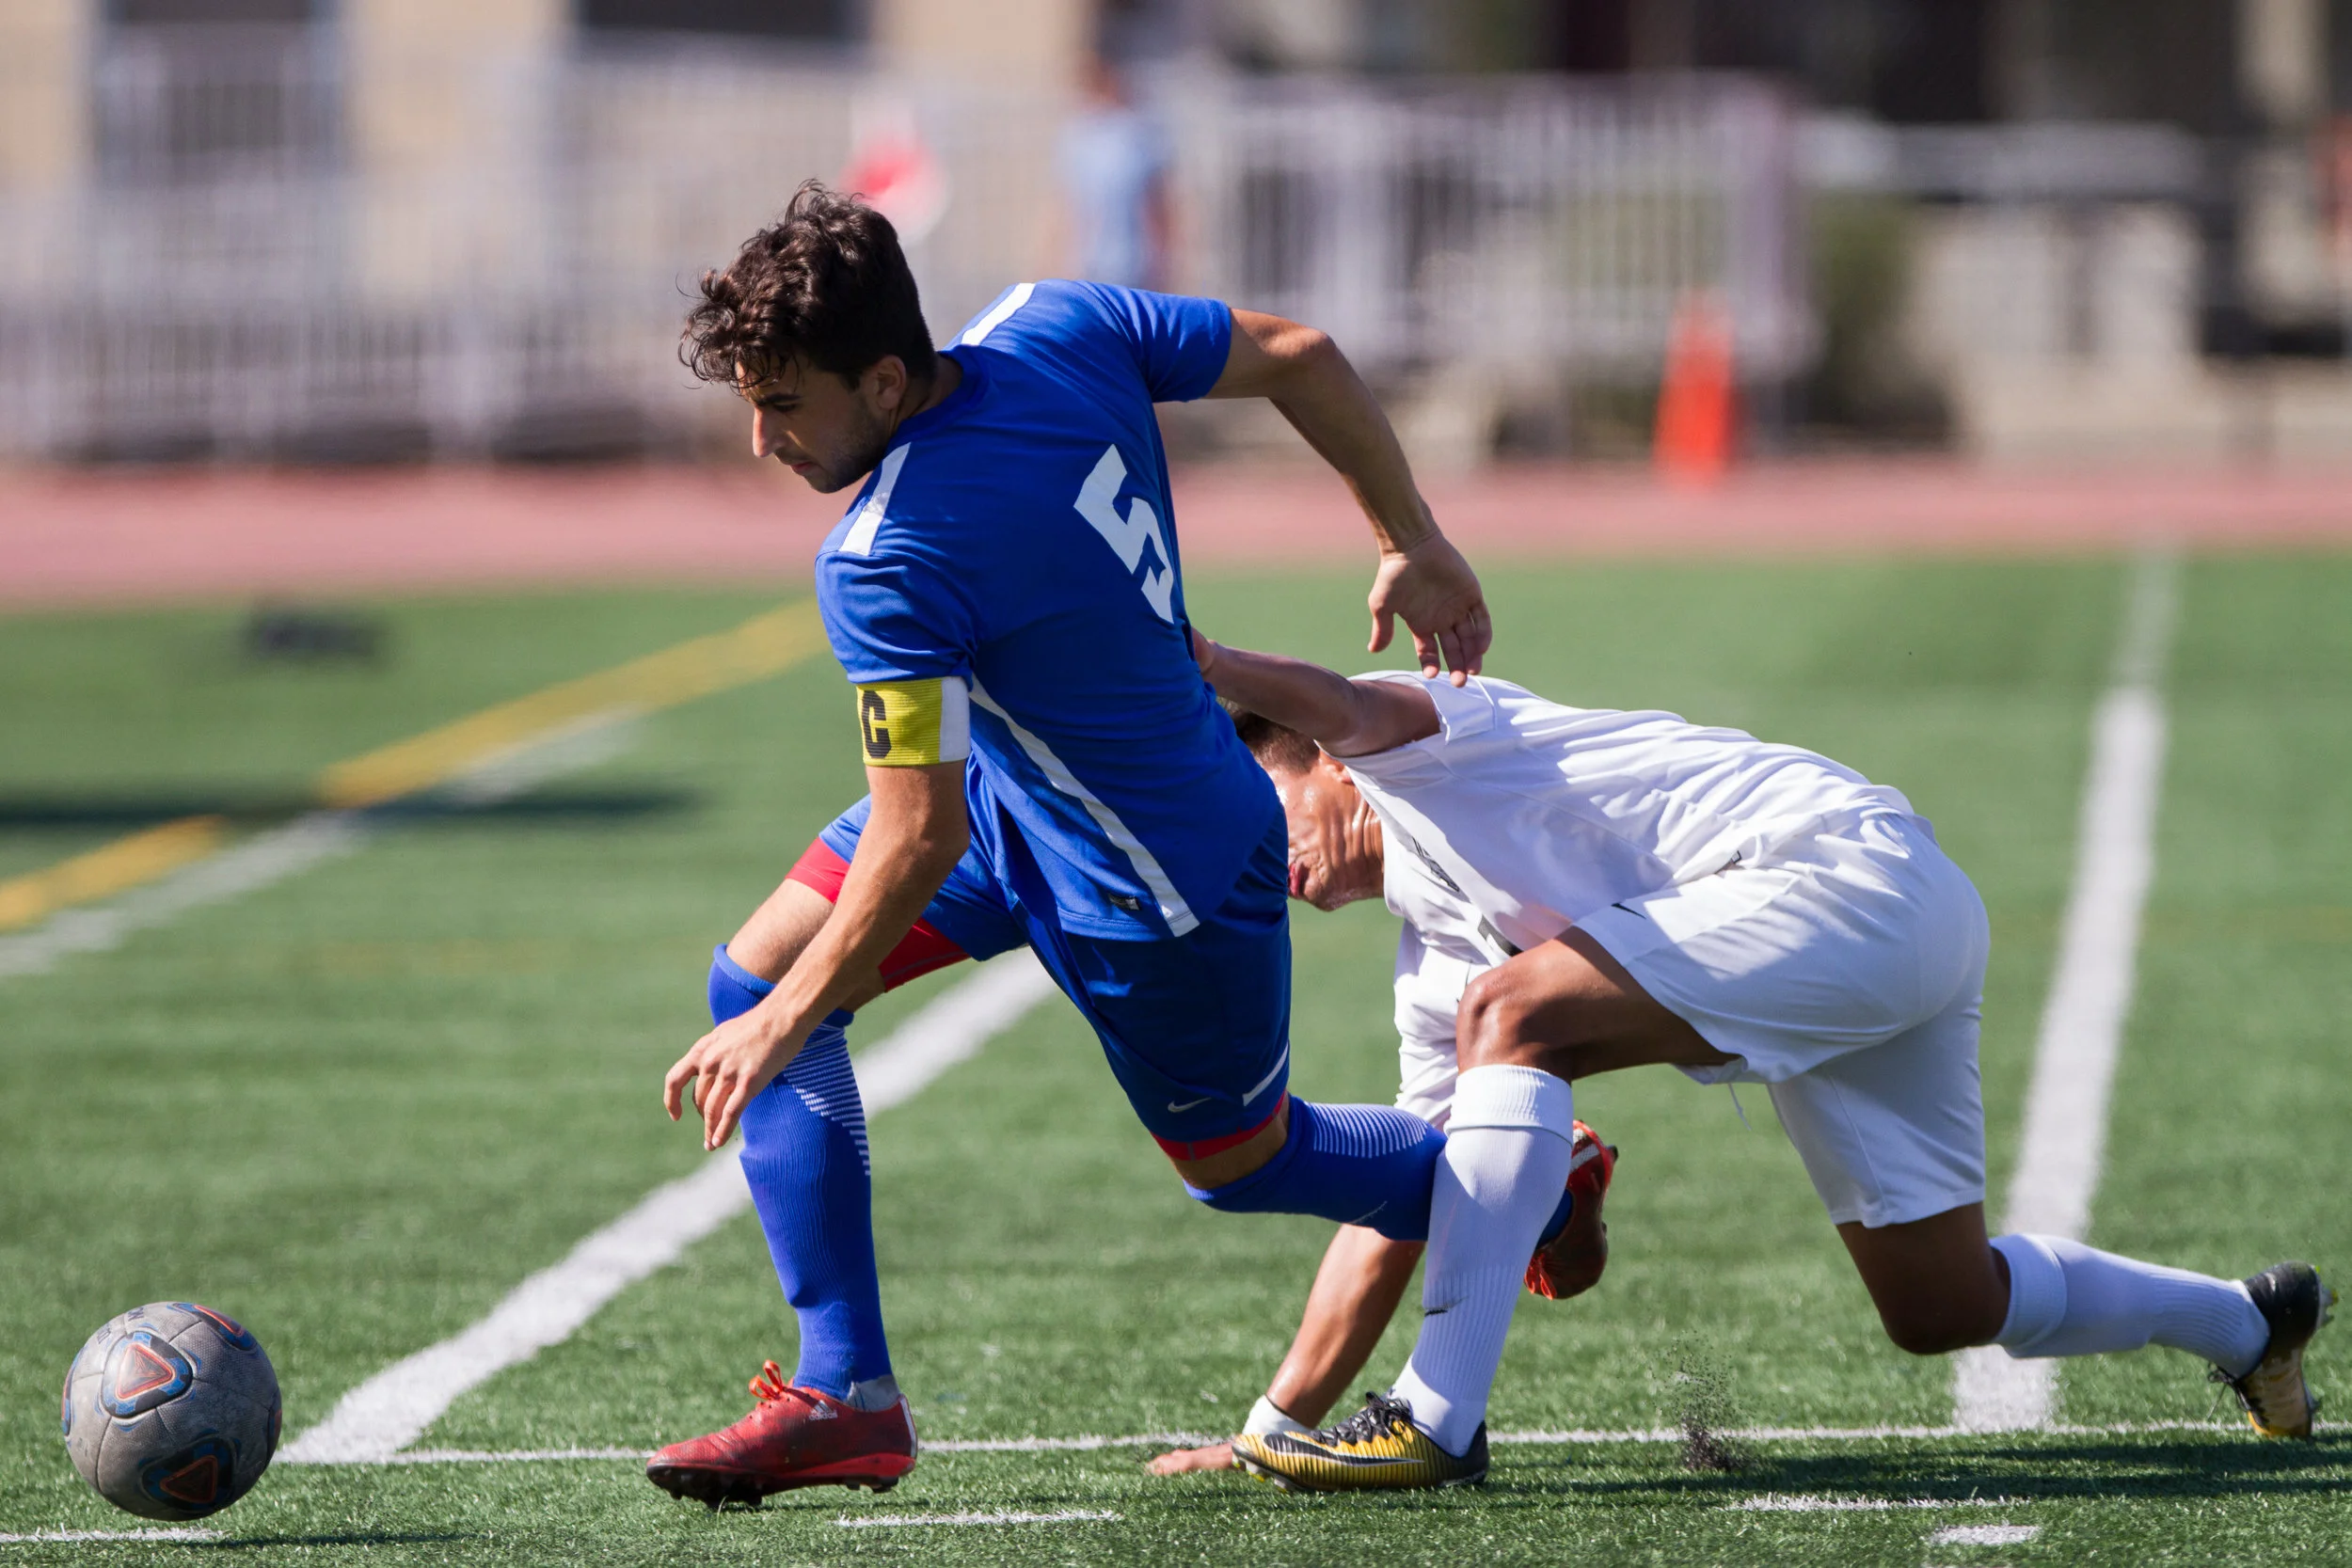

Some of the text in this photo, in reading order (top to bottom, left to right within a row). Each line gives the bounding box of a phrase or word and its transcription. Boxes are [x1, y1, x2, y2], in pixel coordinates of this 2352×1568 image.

[1073, 444, 1174, 625] 5
[862, 689, 892, 758] C
[809, 1410, 837, 1420] adidas
